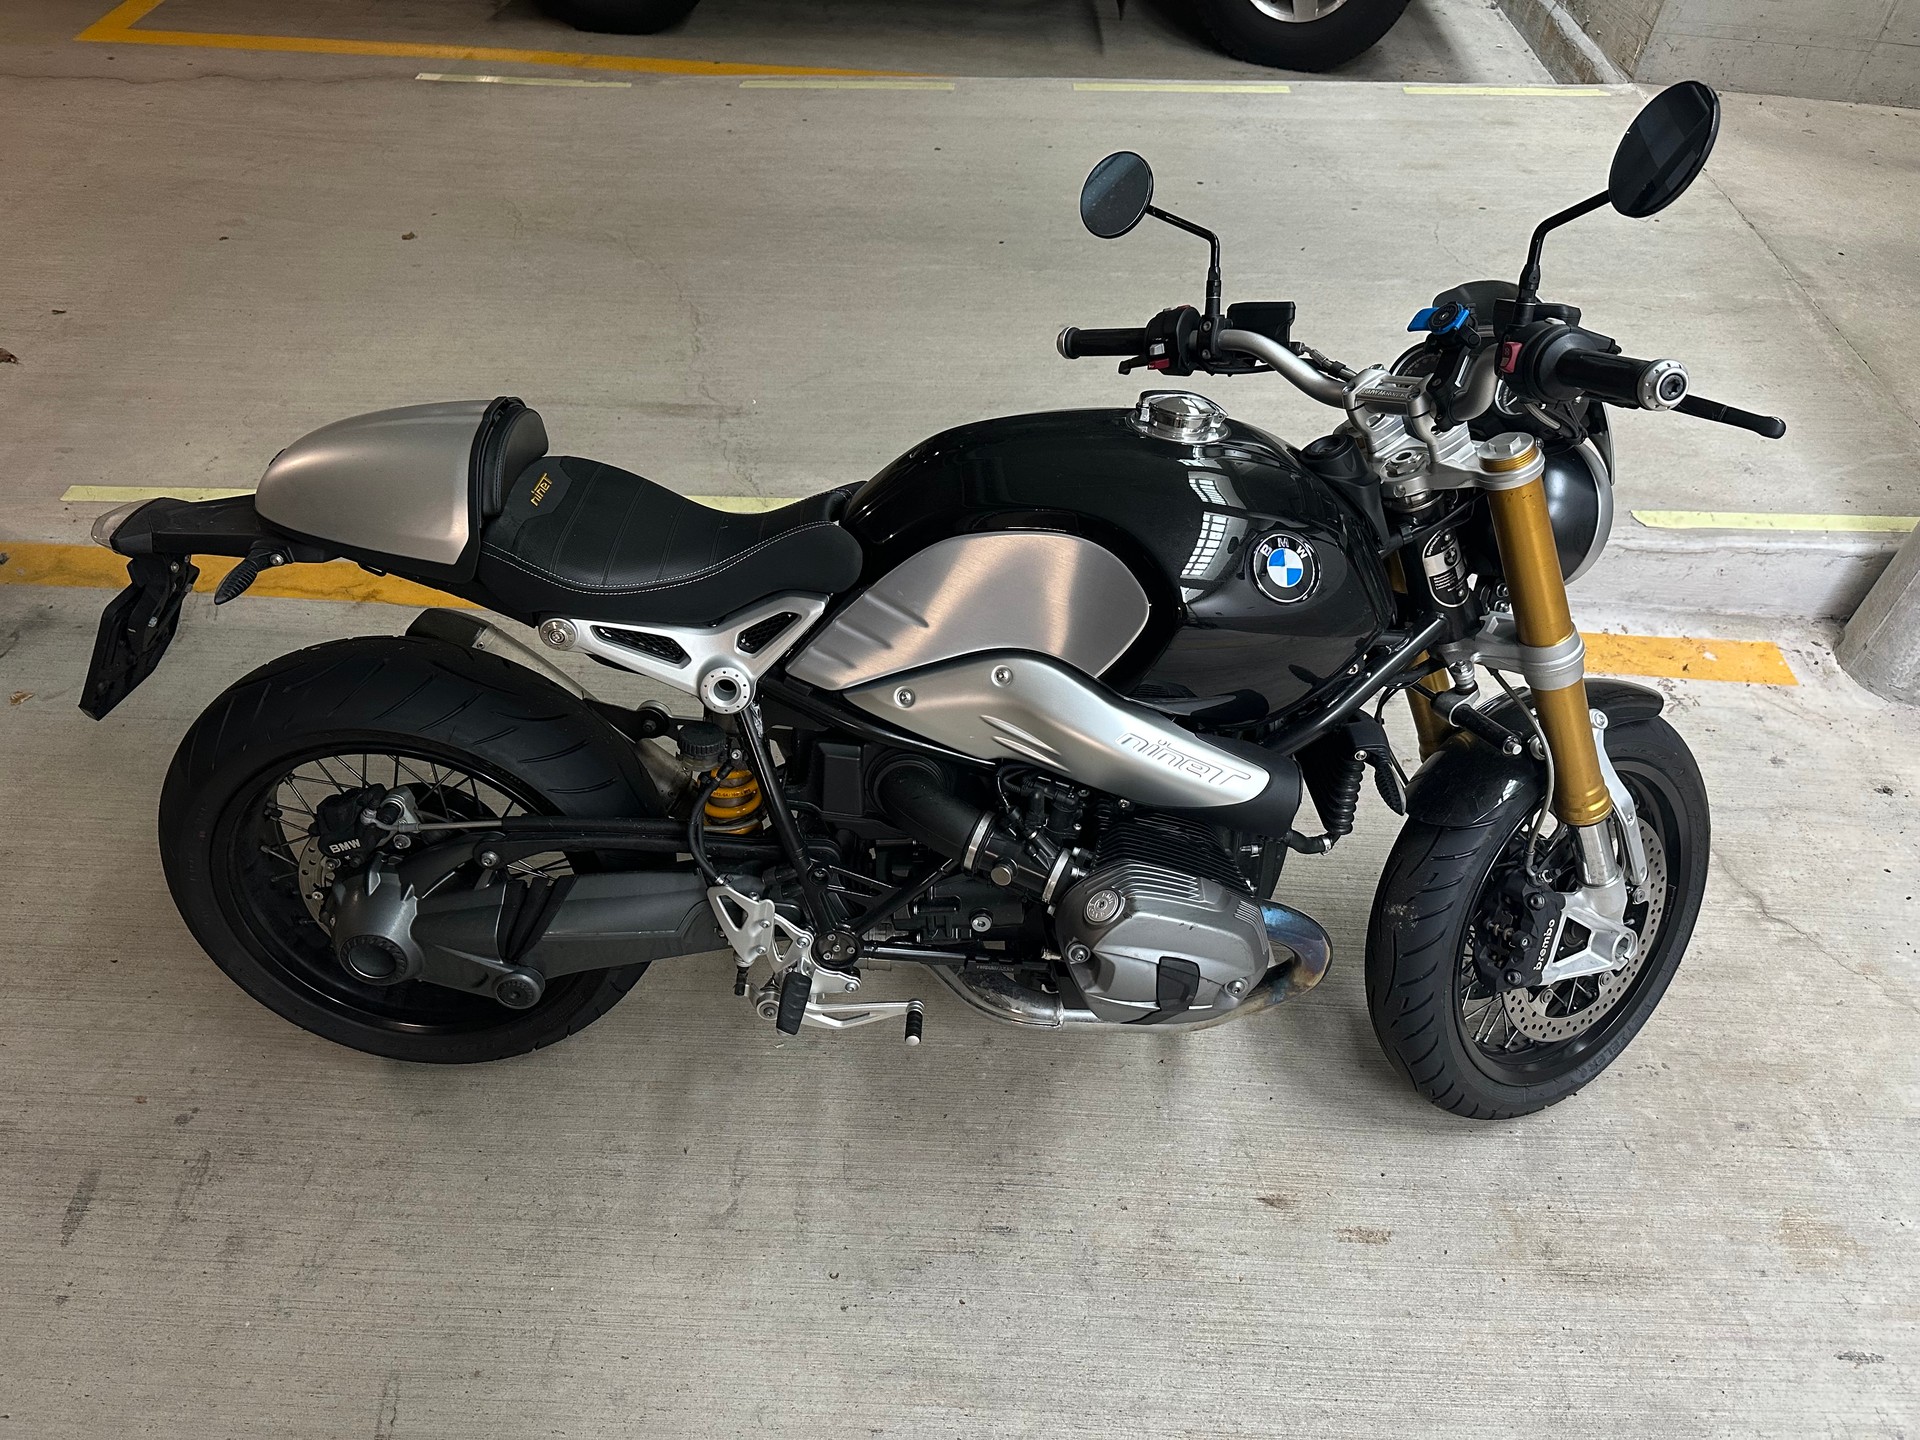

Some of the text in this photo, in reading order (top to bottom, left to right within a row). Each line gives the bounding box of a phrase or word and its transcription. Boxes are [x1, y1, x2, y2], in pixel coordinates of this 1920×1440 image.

[1260, 537, 1308, 559] BMW
[329, 839, 361, 854] BMW
[1533, 919, 1556, 971] brembo
